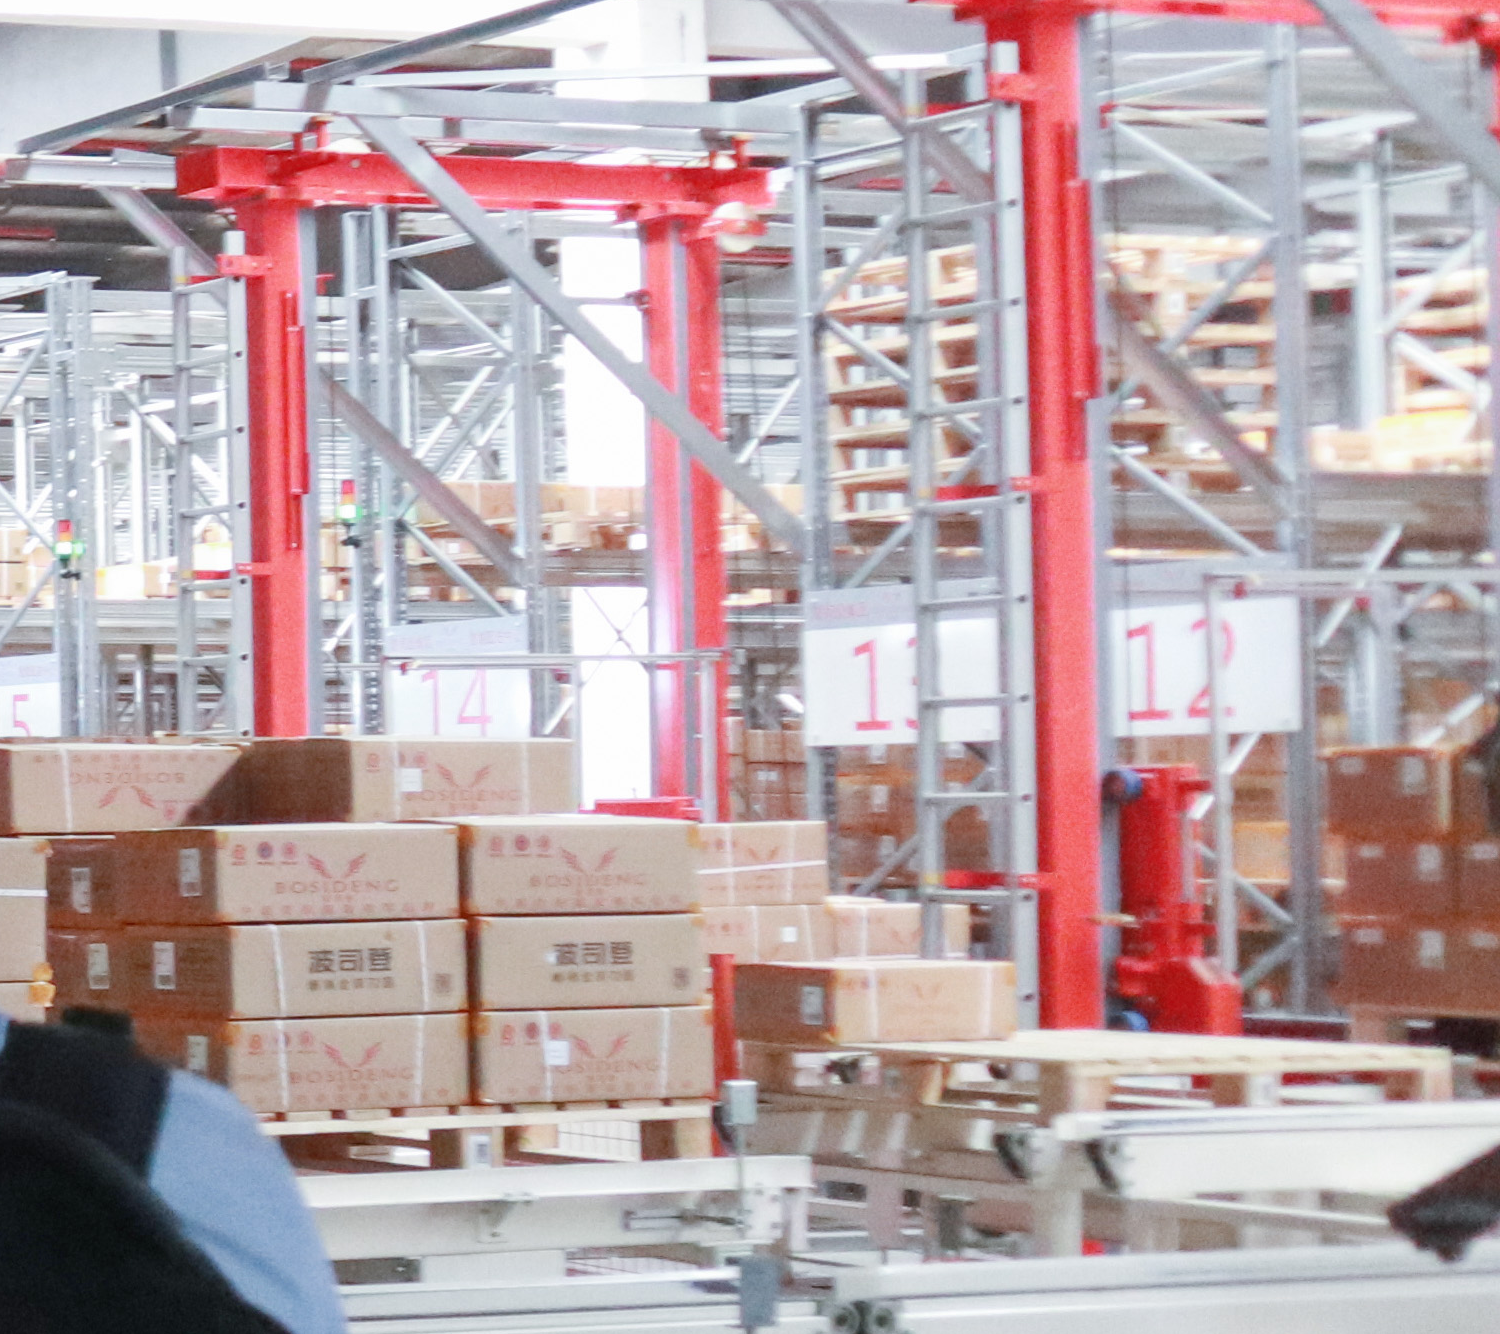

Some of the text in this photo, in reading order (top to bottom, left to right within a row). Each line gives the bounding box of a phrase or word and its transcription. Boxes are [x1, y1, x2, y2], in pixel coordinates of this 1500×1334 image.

[853, 636, 918, 731] 1
[1127, 617, 1236, 721] 12
[420, 668, 493, 737] 14
[275, 879, 399, 894] BOSIDENG
[308, 947, 393, 973] 波司登
[553, 941, 634, 966] 波司登
